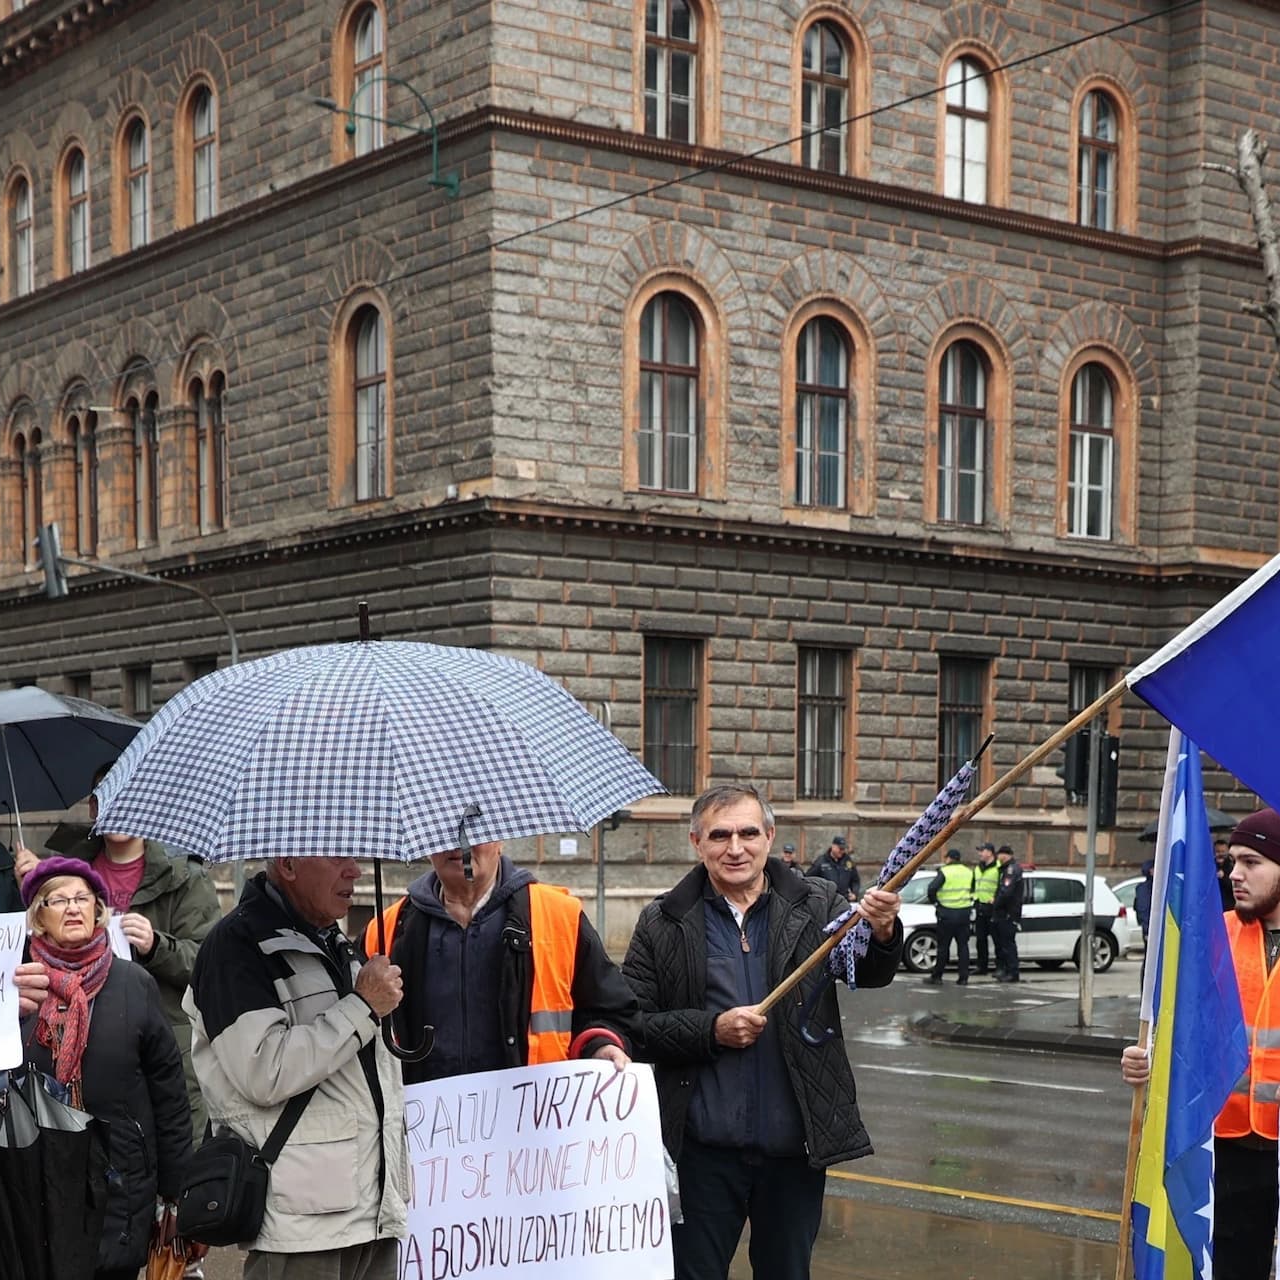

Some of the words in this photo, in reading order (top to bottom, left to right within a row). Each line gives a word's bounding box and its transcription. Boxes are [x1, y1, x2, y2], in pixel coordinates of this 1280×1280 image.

[403, 1087, 501, 1153] RALJU
[512, 1070, 639, 1133] TVRTKO
[419, 1155, 449, 1207] TI
[461, 1151, 496, 1199] SE
[506, 1132, 637, 1197] KUNEMO
[431, 1215, 512, 1280] BOSNU
[517, 1211, 578, 1265] IZDATI
